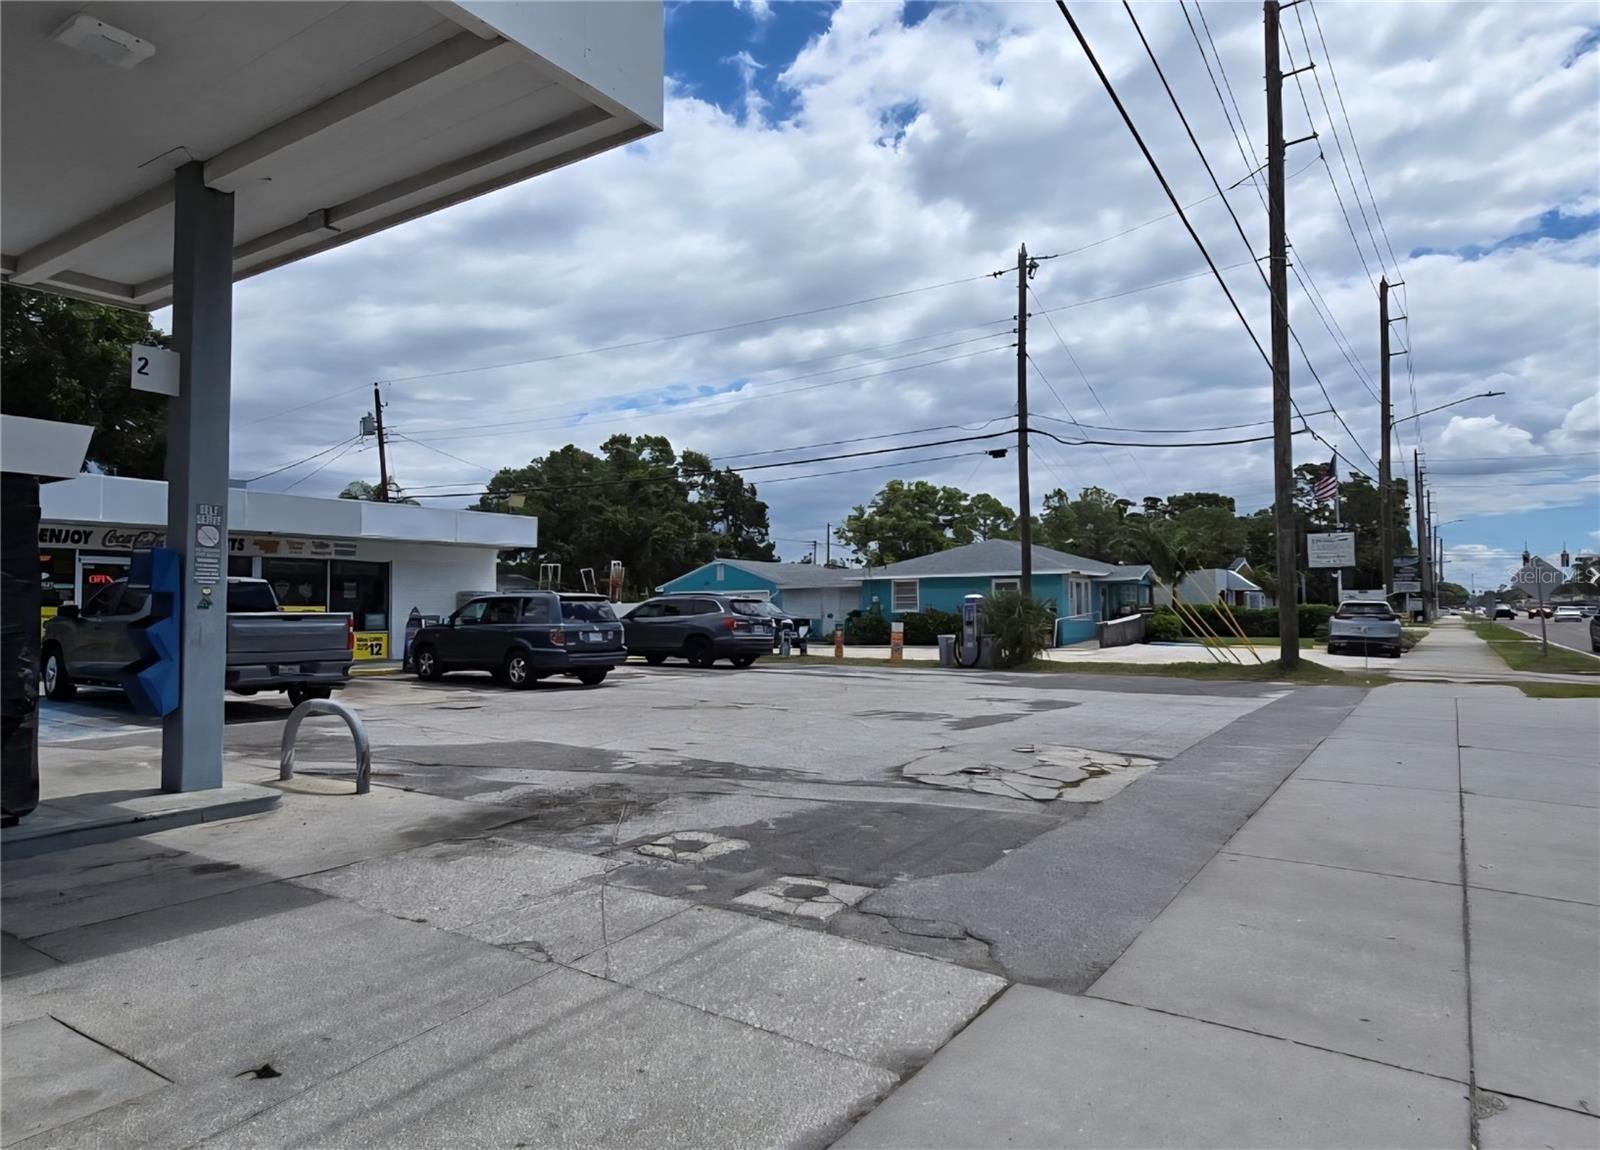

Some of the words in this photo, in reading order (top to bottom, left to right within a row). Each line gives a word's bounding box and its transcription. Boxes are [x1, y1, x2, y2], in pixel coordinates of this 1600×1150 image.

[137, 356, 149, 376] 2
[200, 504, 219, 515] SELF
[39, 527, 94, 544] ENJOY
[370, 642, 382, 656] 12
